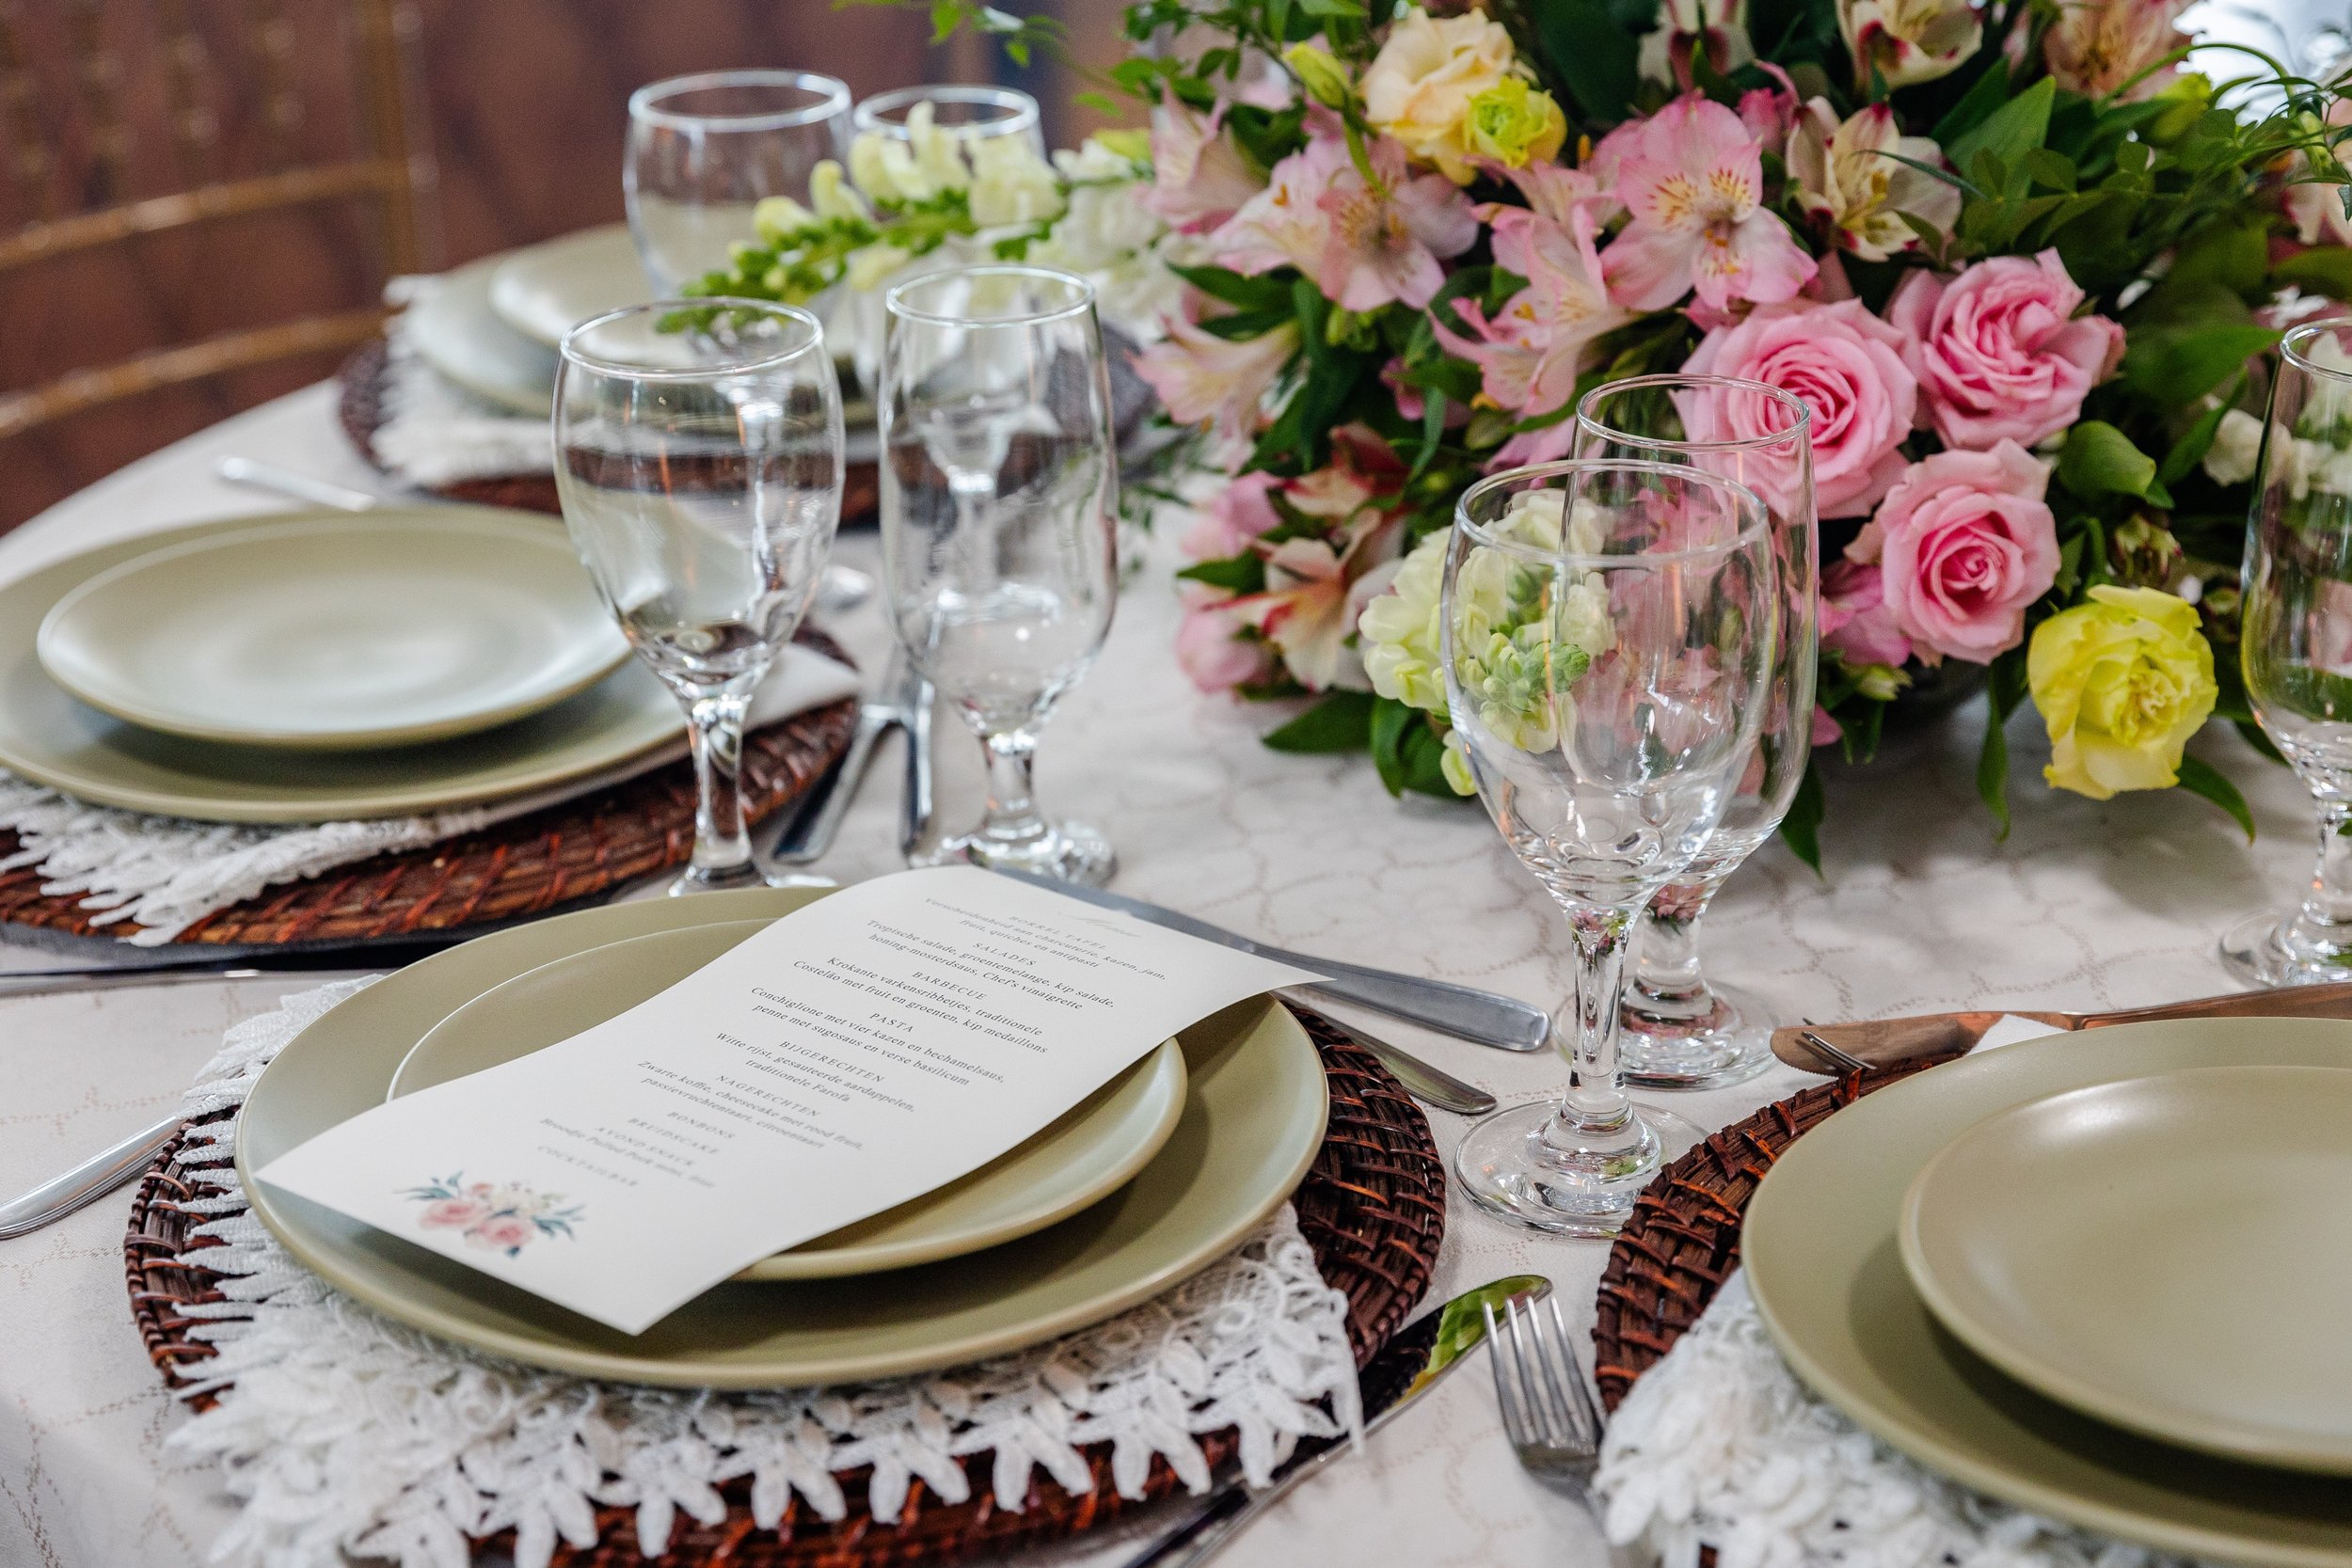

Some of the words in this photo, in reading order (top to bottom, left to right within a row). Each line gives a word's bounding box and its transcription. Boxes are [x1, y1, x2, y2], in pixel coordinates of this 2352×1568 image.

[972, 942, 1037, 968] SALADES
[989, 929, 1034, 946] quiches
[1033, 943, 1049, 952] en
[1049, 949, 1101, 968] antipasti
[1008, 915, 1061, 936] BORREL
[1064, 934, 1107, 950] TAFEL
[1011, 927, 1034, 937] aan
[1034, 934, 1099, 958] charcuterie,
[1102, 956, 1137, 972] kazen,
[1137, 968, 1166, 980] jam,
[866, 919, 921, 942] Tropische
[919, 939, 957, 956] salade,
[958, 952, 1050, 987] groentemelange,
[1053, 982, 1074, 993] kip
[1074, 990, 1114, 1008] salade,
[868, 933, 978, 976] honing-mosterdsaus,
[982, 972, 1020, 989] Chef's
[1021, 985, 1083, 1009] vinaigrette
[912, 971, 987, 1001] BARBECUE
[793, 960, 841, 981] Costelão
[841, 978, 866, 990] met
[864, 985, 893, 999] fruit
[891, 995, 907, 1005] en
[904, 1001, 959, 1023] groenten,
[961, 1019, 983, 1031] kip
[982, 1027, 1048, 1053] medaillons
[827, 957, 879, 979] Krokante
[880, 976, 971, 1014] varkensribbetjes,
[975, 1008, 1042, 1036] traditionele
[751, 987, 824, 1017] Conchiglione
[822, 1014, 848, 1025] met
[848, 1022, 872, 1034] vier
[870, 1029, 906, 1047] kazen
[906, 1043, 923, 1053] en
[922, 1047, 1004, 1084] bechamelsaus,
[752, 1005, 789, 1020] penne
[787, 1014, 813, 1028] met
[810, 1025, 864, 1047] sugosaus
[863, 1044, 880, 1053] en
[881, 1050, 912, 1065] verse
[912, 1059, 970, 1086] basilicum
[868, 1012, 914, 1033] PASTA
[716, 1032, 746, 1048] Witte
[746, 1045, 773, 1060] rijst,
[771, 1056, 843, 1085] gesauteerde
[842, 1081, 914, 1113] aardappelen,
[745, 1059, 812, 1087] traditionele
[810, 1083, 850, 1102] Farofa
[778, 1040, 885, 1083] BIJGERECHTEN
[637, 1060, 678, 1079] Zwarte
[675, 1075, 712, 1094] koffie,
[715, 1090, 780, 1117] cheesecake
[778, 1115, 806, 1128] met
[714, 1075, 821, 1117] NAGERECHTEN
[666, 1111, 736, 1140] BONBONS
